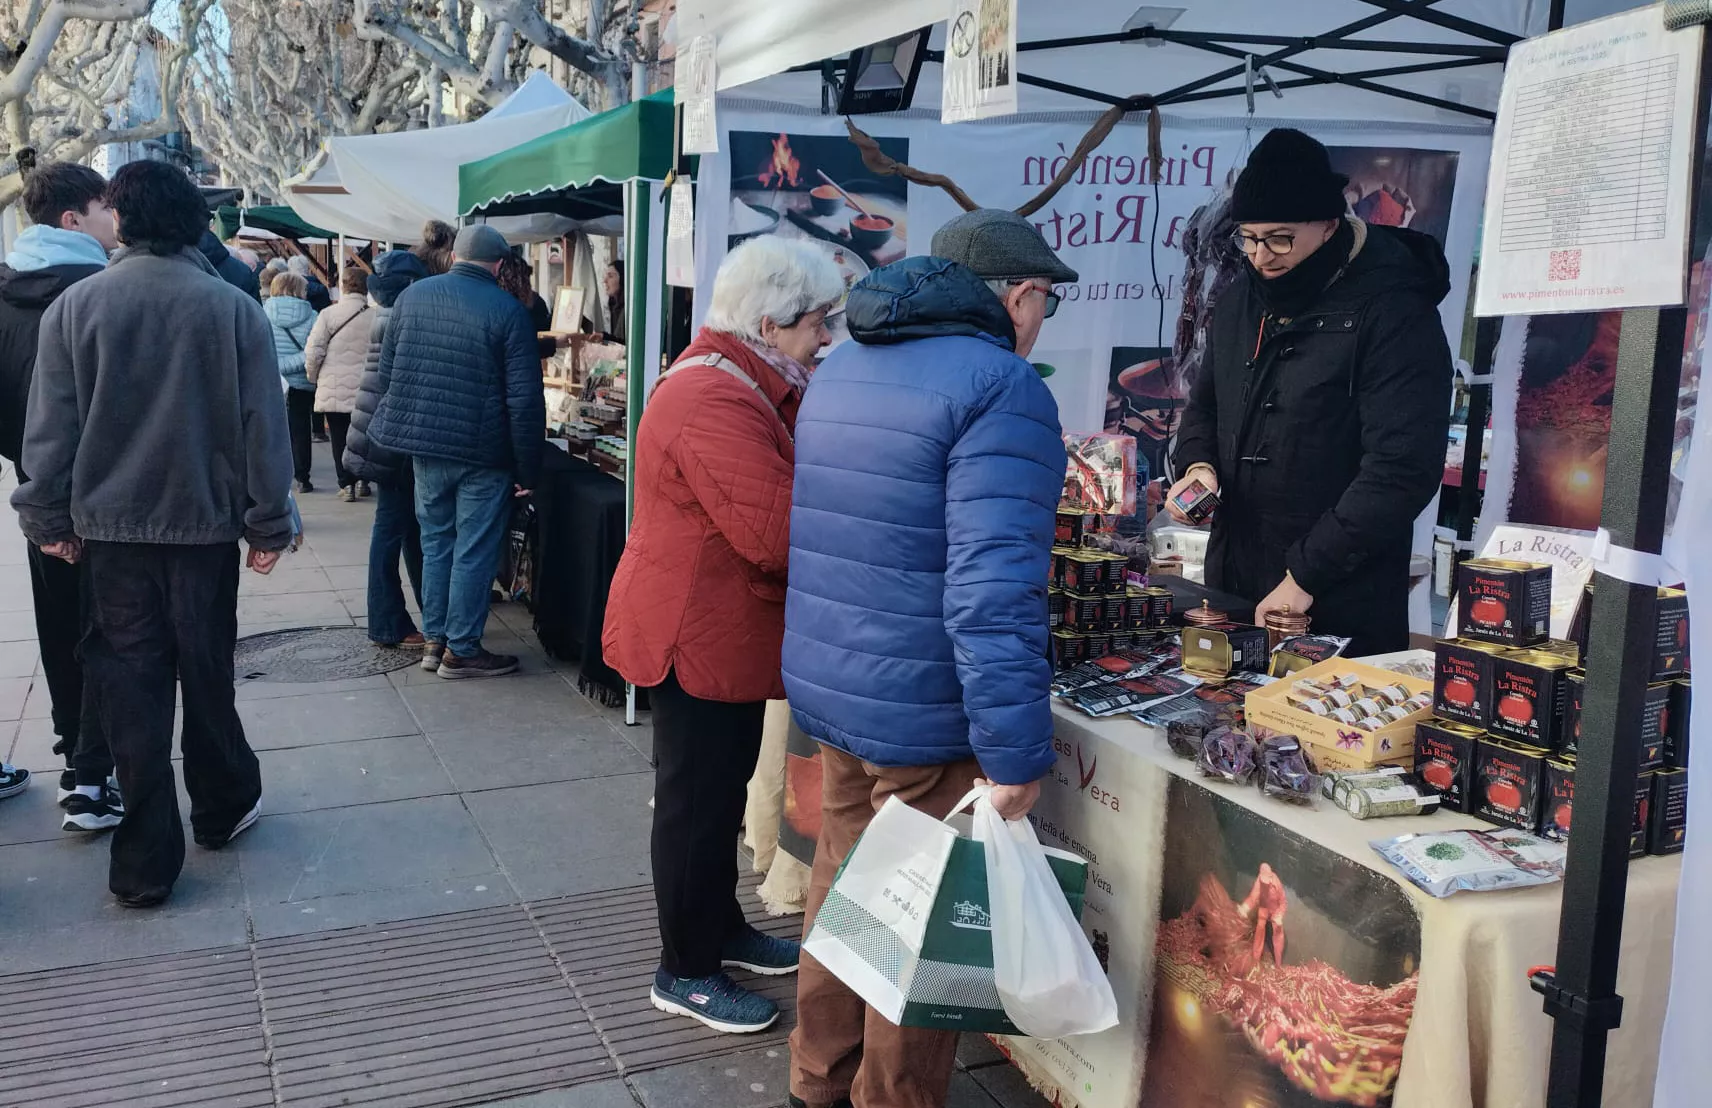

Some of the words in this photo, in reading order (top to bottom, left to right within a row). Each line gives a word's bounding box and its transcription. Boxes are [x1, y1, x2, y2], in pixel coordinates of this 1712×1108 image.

[1498, 539, 1523, 556] La
[1529, 535, 1586, 570] Ristra
[1475, 577, 1505, 587] Pimentón
[1468, 585, 1481, 595] La
[1482, 585, 1512, 600] Ristra
[1448, 656, 1476, 669] Pimentón
[1441, 664, 1453, 674] La
[1455, 665, 1480, 681] Ristra
[1505, 671, 1534, 685] Pimentón
[1497, 680, 1510, 690] La
[1511, 680, 1537, 698] Ristra
[1052, 737, 1072, 757] as
[1427, 738, 1454, 751] Pimentón
[1420, 745, 1433, 756] La
[1434, 748, 1459, 765] Ristra
[1492, 757, 1522, 772] Pimentón
[1058, 770, 1069, 787] La
[1076, 740, 1121, 813] Vera
[1486, 765, 1499, 776] La
[1499, 767, 1527, 786] Ristra
[1040, 816, 1058, 838] leña
[1059, 828, 1070, 845] de
[1071, 838, 1100, 866] encina.
[1090, 869, 1115, 896] Vera.
